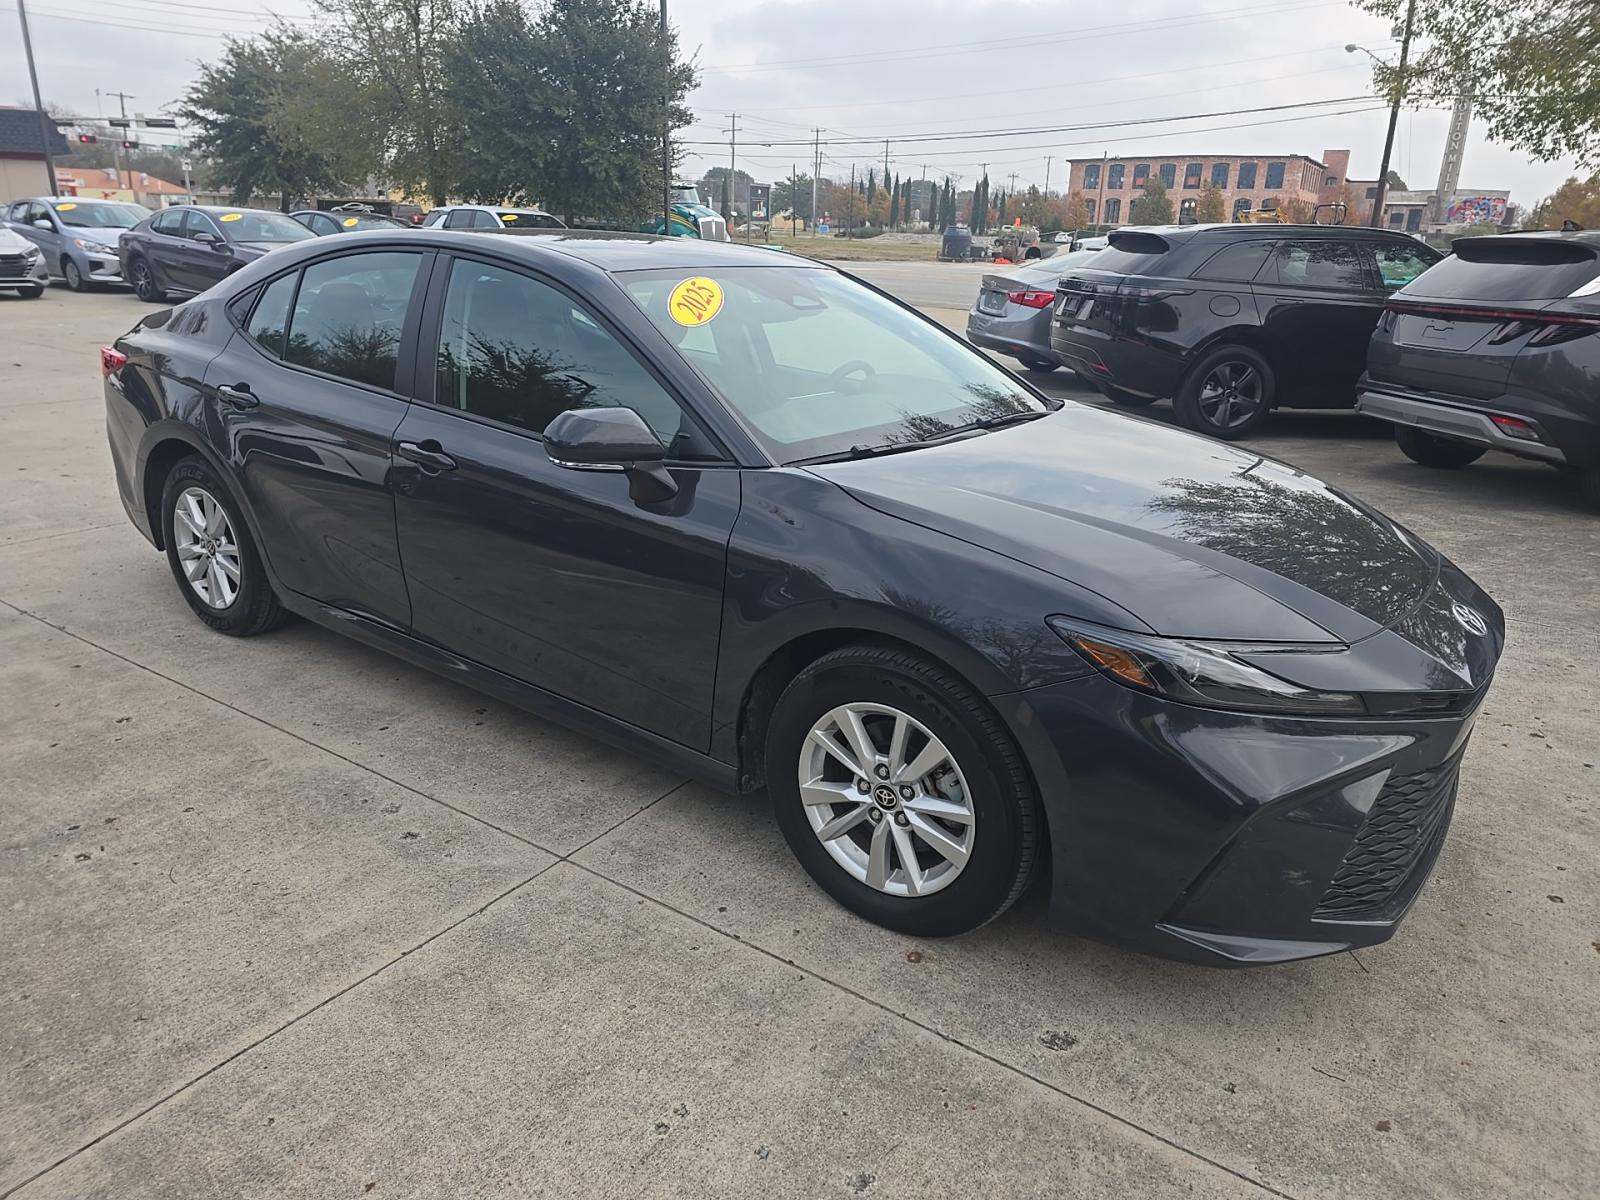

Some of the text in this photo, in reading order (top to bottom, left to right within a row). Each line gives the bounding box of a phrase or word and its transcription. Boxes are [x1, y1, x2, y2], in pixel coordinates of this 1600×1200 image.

[1444, 97, 1468, 191] OTTON MILL
[677, 281, 715, 321] 2025
